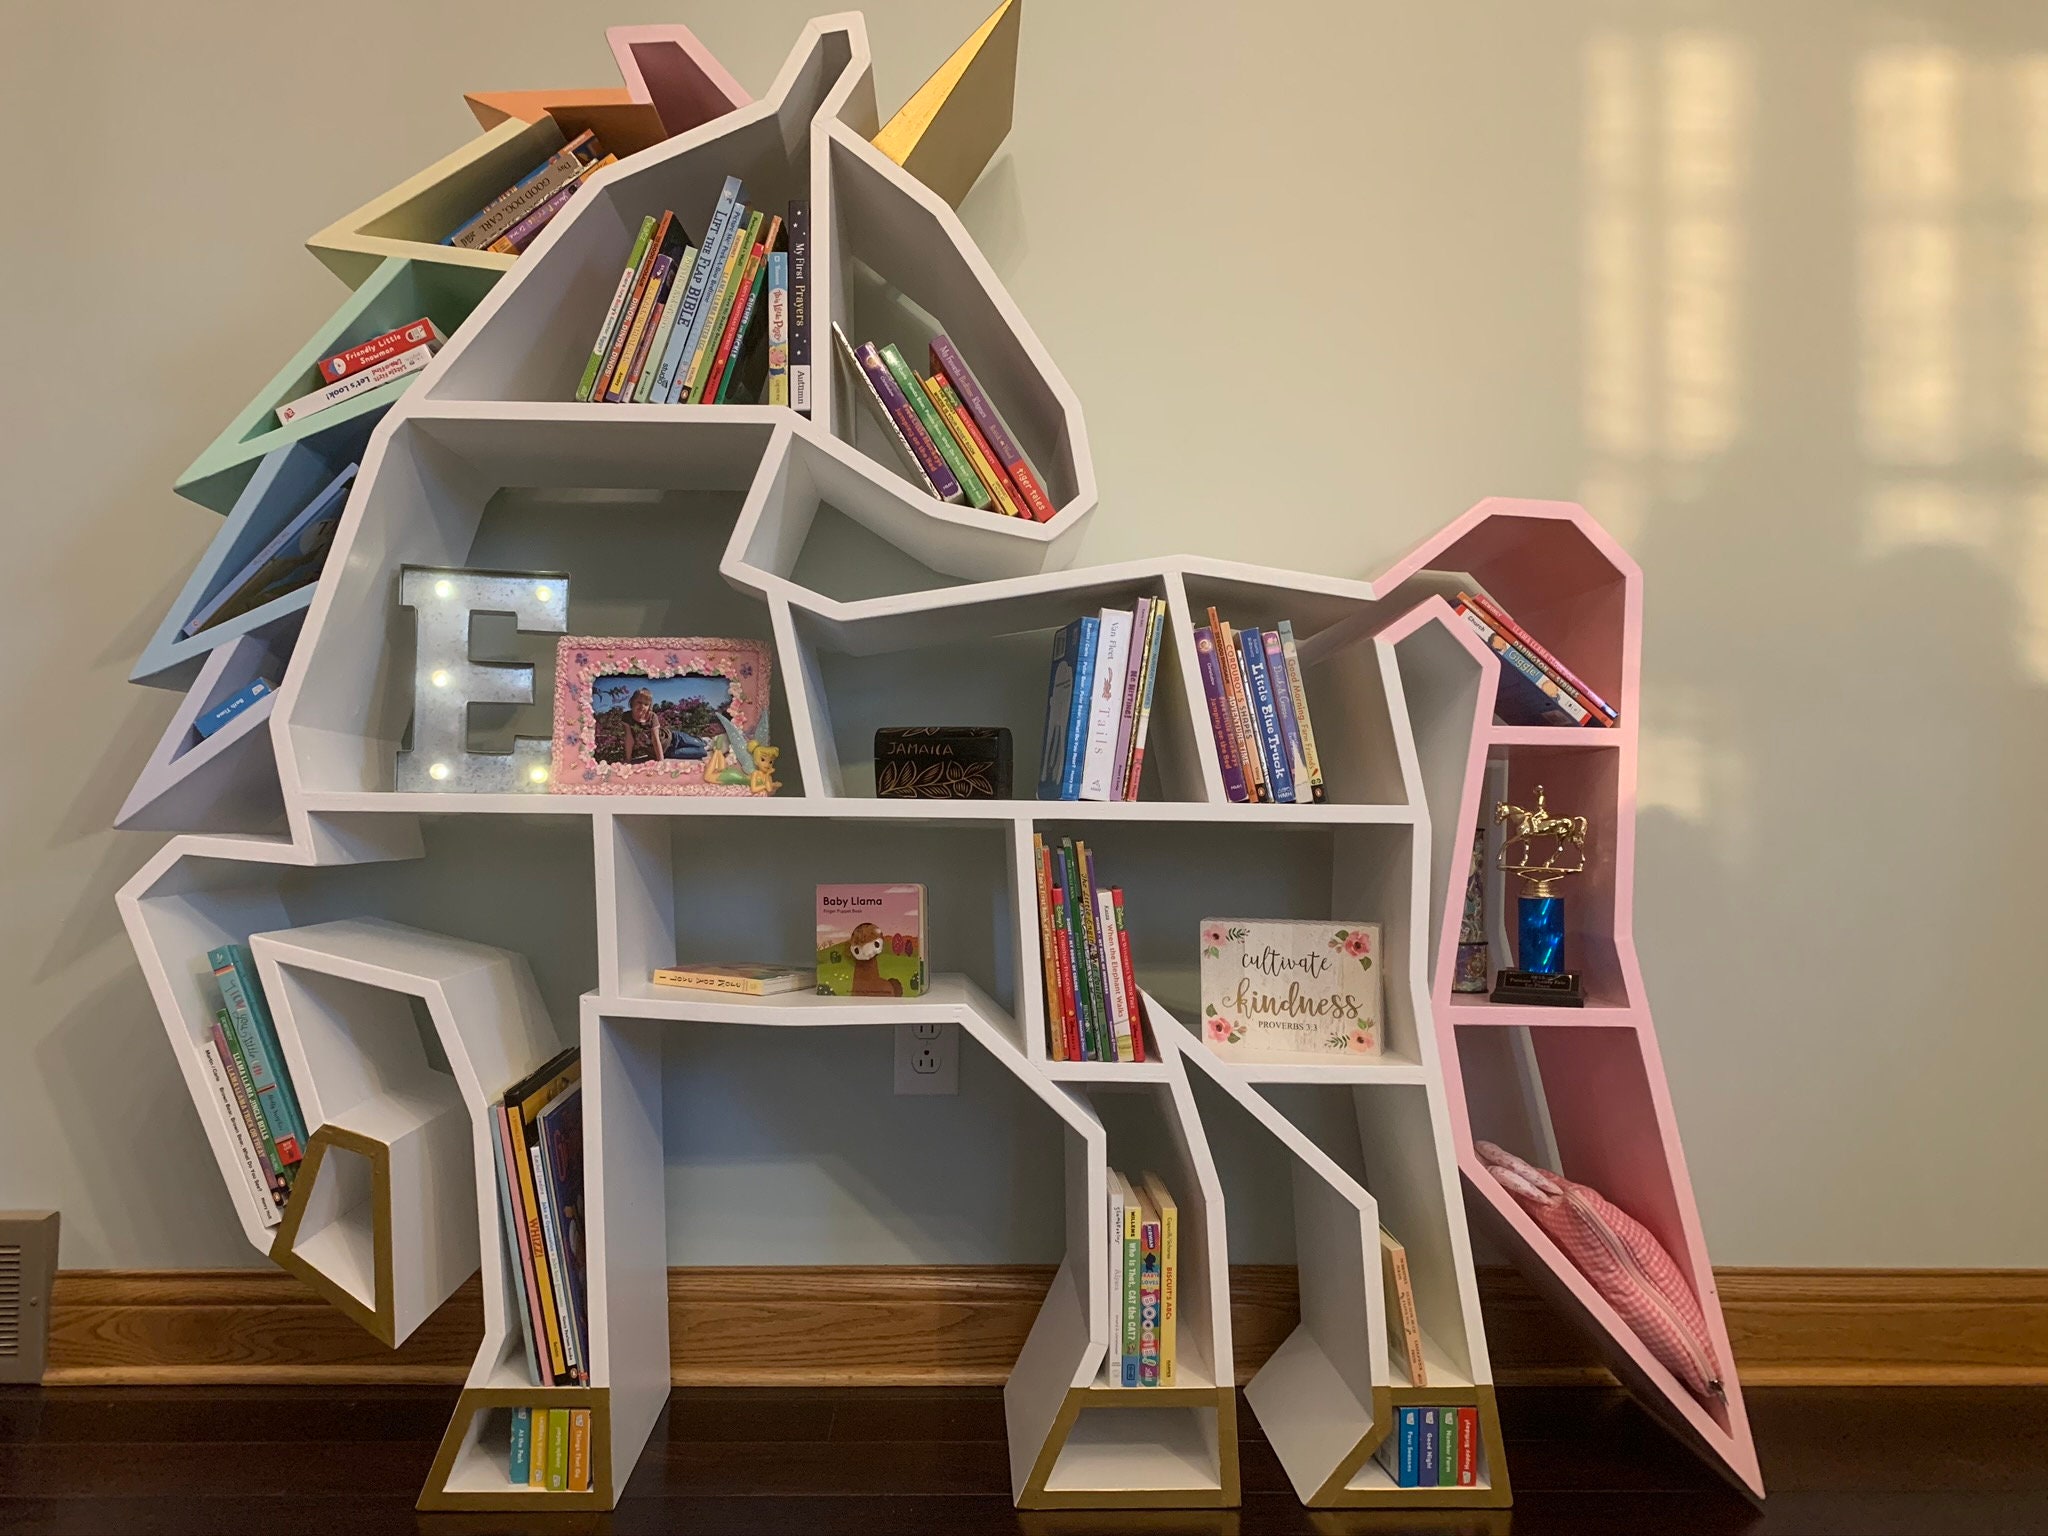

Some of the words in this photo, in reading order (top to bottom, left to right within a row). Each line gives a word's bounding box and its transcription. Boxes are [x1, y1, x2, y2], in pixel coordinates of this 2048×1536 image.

[523, 176, 550, 199] GOOD
[500, 194, 525, 216] DOG,
[478, 211, 504, 233] CARL
[709, 209, 727, 234] LIFT
[727, 211, 740, 233] Picture
[701, 235, 714, 254] THE
[729, 234, 741, 258] DEWDNEY
[794, 243, 804, 255] My
[691, 256, 711, 284] FLAP
[712, 245, 728, 278] Peek-A-Boo
[703, 279, 717, 303] Bedtime
[716, 271, 729, 294] LLAMA
[676, 285, 701, 327] BIBLE
[708, 294, 721, 316] LLAMA
[740, 292, 756, 324] CRUSHER
[774, 290, 783, 303] This
[793, 285, 805, 326] Prayers
[624, 297, 638, 322] DINOS,
[774, 304, 784, 320] Little
[613, 324, 628, 350] DINOS,
[700, 315, 714, 339] EASTER
[772, 321, 784, 341] Piggy
[345, 343, 376, 361] Friendly
[377, 332, 401, 347] Little
[359, 345, 395, 364] Snowman
[696, 338, 706, 351] EGG
[729, 333, 743, 359] PICKLE
[603, 350, 618, 377] DINOS!
[656, 362, 669, 385] studio
[324, 384, 349, 400] Look!
[349, 375, 370, 389] Let's
[939, 344, 951, 357] My
[970, 395, 989, 419] Rhymes
[902, 402, 916, 419] Five
[911, 417, 926, 437] Little
[922, 435, 944, 467] Monkeys
[933, 391, 946, 408] WHERE
[946, 412, 957, 426] YOUR
[955, 425, 967, 442] NOSE?
[965, 441, 975, 455] BOOK
[894, 406, 915, 438] Jumping
[911, 435, 921, 446] on
[917, 445, 929, 459] the
[925, 457, 937, 472] Bed
[1014, 466, 1034, 490] tiger
[1028, 488, 1046, 511] tales
[1480, 598, 1502, 618] DEWDNEY
[1109, 621, 1119, 637] Van
[1466, 614, 1486, 632] Church
[1106, 640, 1117, 660] Fleet
[1511, 624, 1530, 642] LLAMA
[1529, 640, 1549, 658] LLAMA
[1206, 662, 1215, 685] Christelow
[1287, 658, 1298, 683] Good
[1506, 648, 1540, 680] Giggle!
[1512, 639, 1549, 673] DARINGTON
[1553, 675, 1579, 699] STRIPES
[397, 565, 571, 794] E
[1226, 643, 1244, 702] CORDUROY'S
[1239, 705, 1252, 739] SHAPES
[1251, 662, 1270, 702] Little
[215, 706, 230, 720] Time
[229, 697, 244, 710] Bath
[1209, 697, 1222, 730] Jumping
[1218, 695, 1228, 712] Five
[1291, 684, 1307, 722] Morning,
[1093, 706, 1110, 754] Tails
[1222, 712, 1232, 731] Little
[1228, 695, 1243, 738] ADVENTURE
[1237, 738, 1249, 765] TIME
[1260, 704, 1277, 734] Blue
[1217, 730, 1224, 740] on
[1300, 723, 1311, 742] Farm
[887, 742, 954, 755] JAMAICA
[1220, 740, 1228, 754] the
[1226, 732, 1239, 768] Monkeys
[1266, 734, 1286, 779] Truck
[1304, 743, 1316, 769] Friends
[1223, 754, 1231, 769] Bed
[1080, 873, 1088, 887] The
[823, 896, 848, 907] Baby
[851, 896, 882, 905] Llama
[1082, 889, 1092, 915] Little
[1115, 907, 1126, 929] Disney's
[1105, 923, 1115, 946] When
[1109, 947, 1117, 960] the
[1241, 945, 1333, 979] cultivate
[1109, 961, 1122, 994] Elephant
[1115, 995, 1125, 1017] Walks
[1221, 977, 1363, 1019] kindness
[1258, 1020, 1304, 1031] PROVERBS
[204, 1049, 214, 1064] Martin
[211, 1068, 221, 1082] Carle
[225, 1064, 239, 1087] LLAMA
[218, 1086, 229, 1103] Brown
[232, 1052, 246, 1075] LLAMA
[240, 1075, 254, 1098] LLAMA
[248, 1097, 262, 1120] JINGLE
[256, 1120, 269, 1140] BELLS
[234, 1086, 247, 1109] LLAMA
[224, 1102, 234, 1117] Bear,
[242, 1108, 254, 1129] TRICK
[230, 1116, 240, 1133] Brown
[249, 1128, 257, 1137] OR
[235, 1132, 245, 1147] Bear,
[252, 1137, 265, 1158] TREAT
[241, 1146, 250, 1160] What
[247, 1160, 254, 1169] Do
[250, 1169, 258, 1179] You
[254, 1179, 262, 1192] See?
[528, 1217, 544, 1258] WHIZZ!
[1128, 1242, 1136, 1257] Who
[1128, 1259, 1135, 1267] Is
[1127, 1268, 1135, 1286] That,
[1140, 1294, 1157, 1366] BOOGIE!
[574, 1468, 580, 1478] Go
